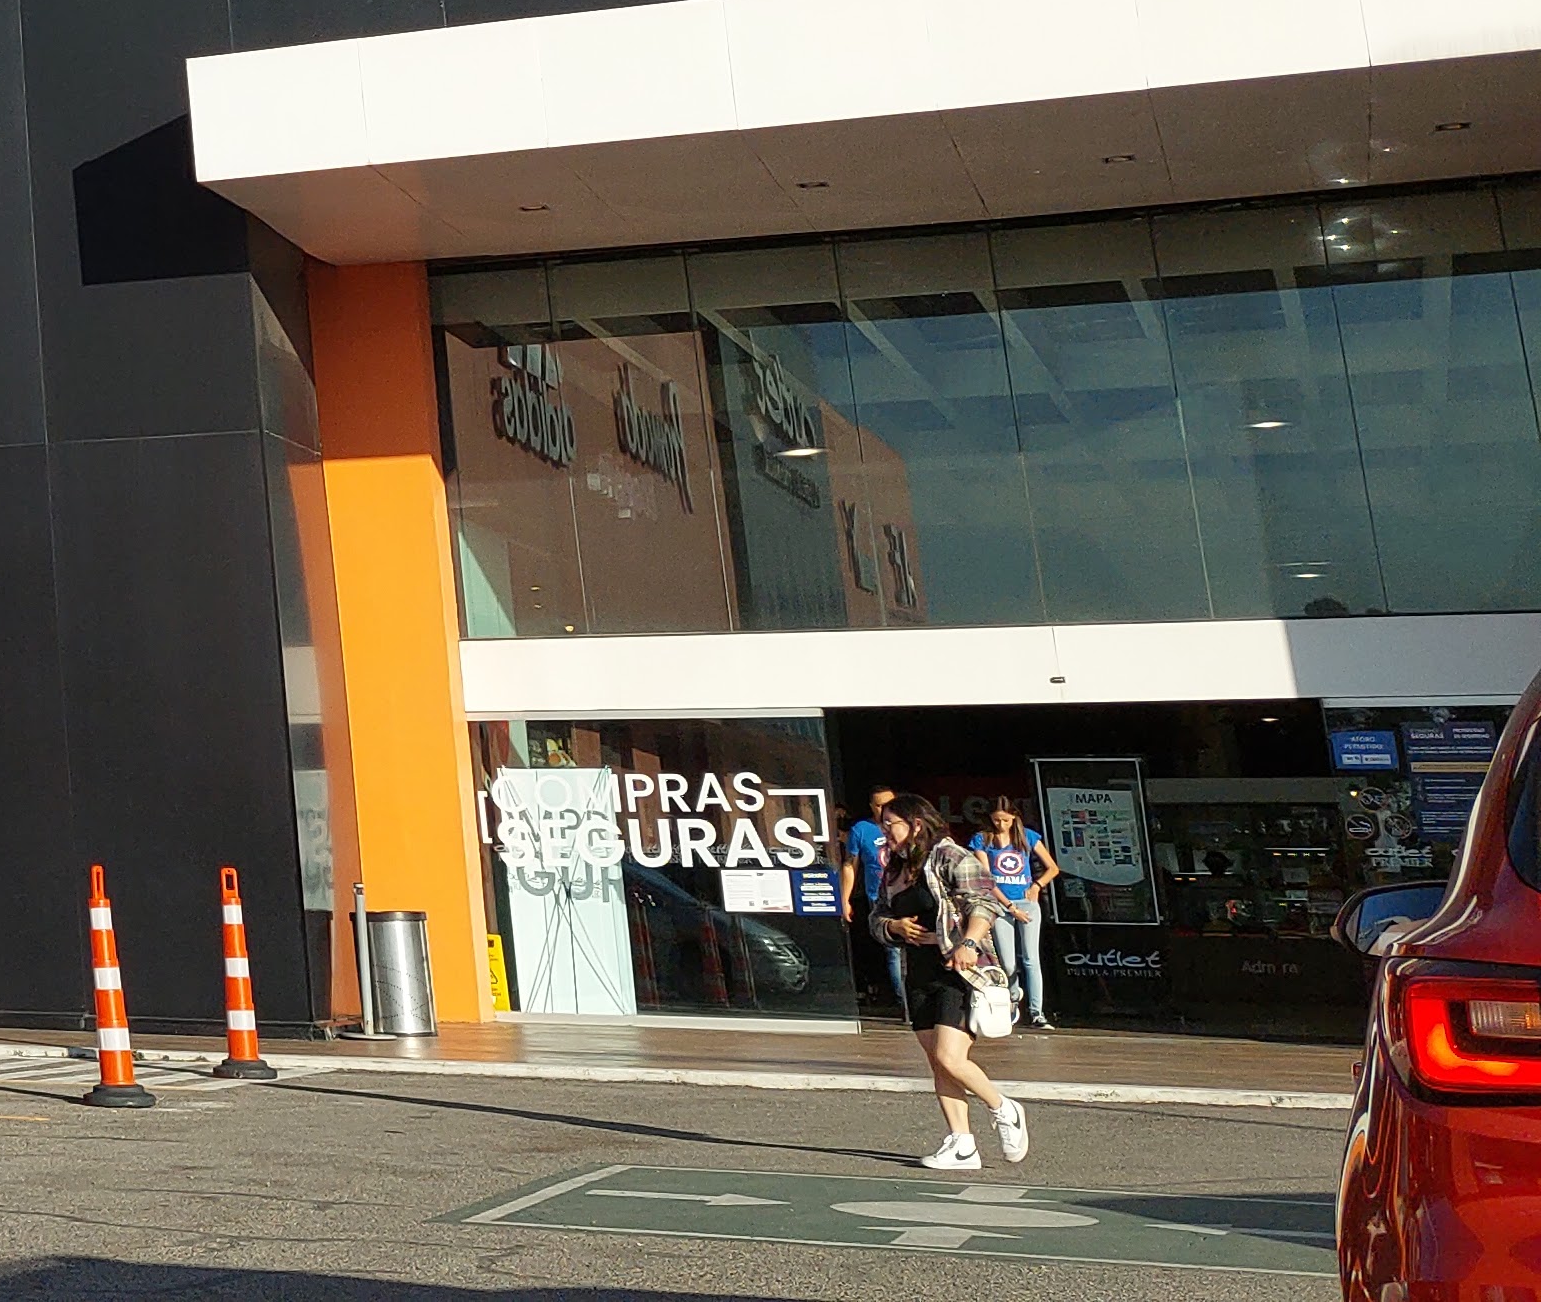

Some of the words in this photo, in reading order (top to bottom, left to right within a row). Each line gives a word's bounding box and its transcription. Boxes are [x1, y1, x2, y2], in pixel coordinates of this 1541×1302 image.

[492, 771, 765, 813] COMPRAS
[1076, 793, 1112, 803] MAPA
[498, 817, 815, 869] SEGURAS
[1064, 949, 1162, 968] outlet
